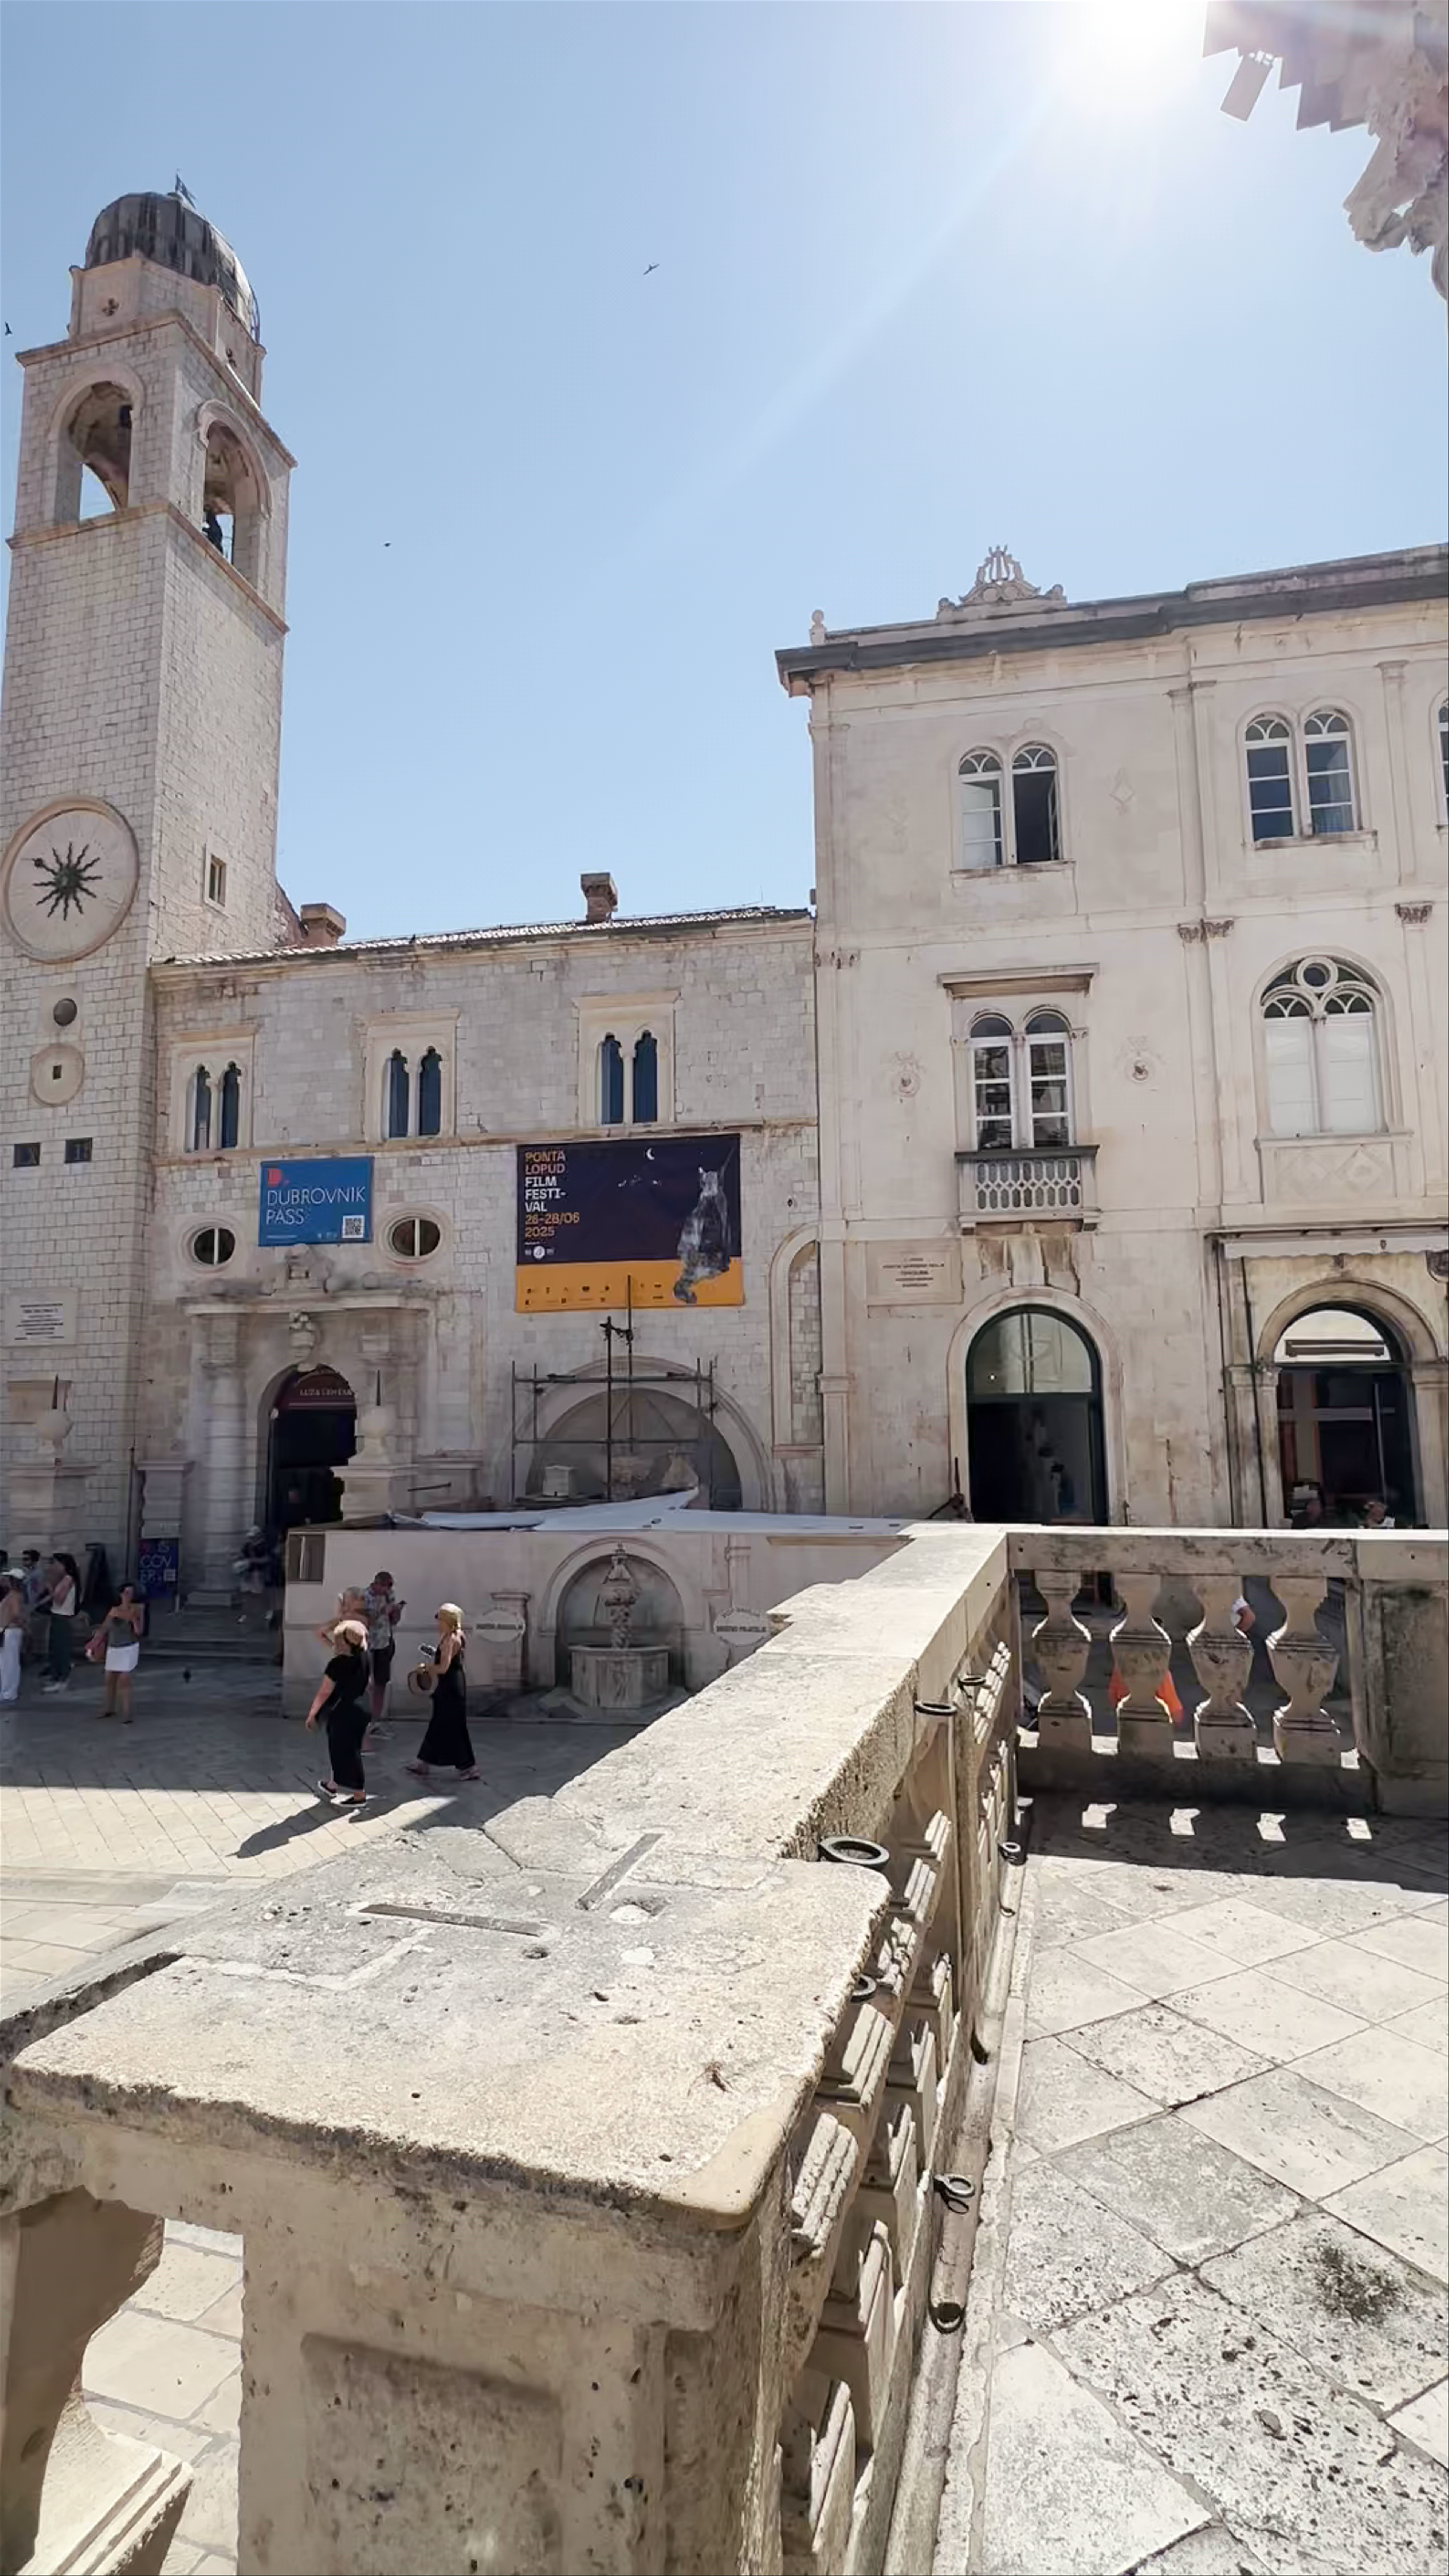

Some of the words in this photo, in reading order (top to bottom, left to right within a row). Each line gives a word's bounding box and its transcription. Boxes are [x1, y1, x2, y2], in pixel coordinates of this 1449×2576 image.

[525, 1151, 566, 1162] PONTA
[525, 1163, 565, 1175] LOPUD
[525, 1176, 557, 1187] FILM
[267, 1186, 365, 1206] DUBROVNIK
[525, 1188, 566, 1200] FESTI-
[525, 1201, 548, 1212] VAL
[266, 1207, 304, 1225] PASS
[525, 1227, 555, 1238] 2025
